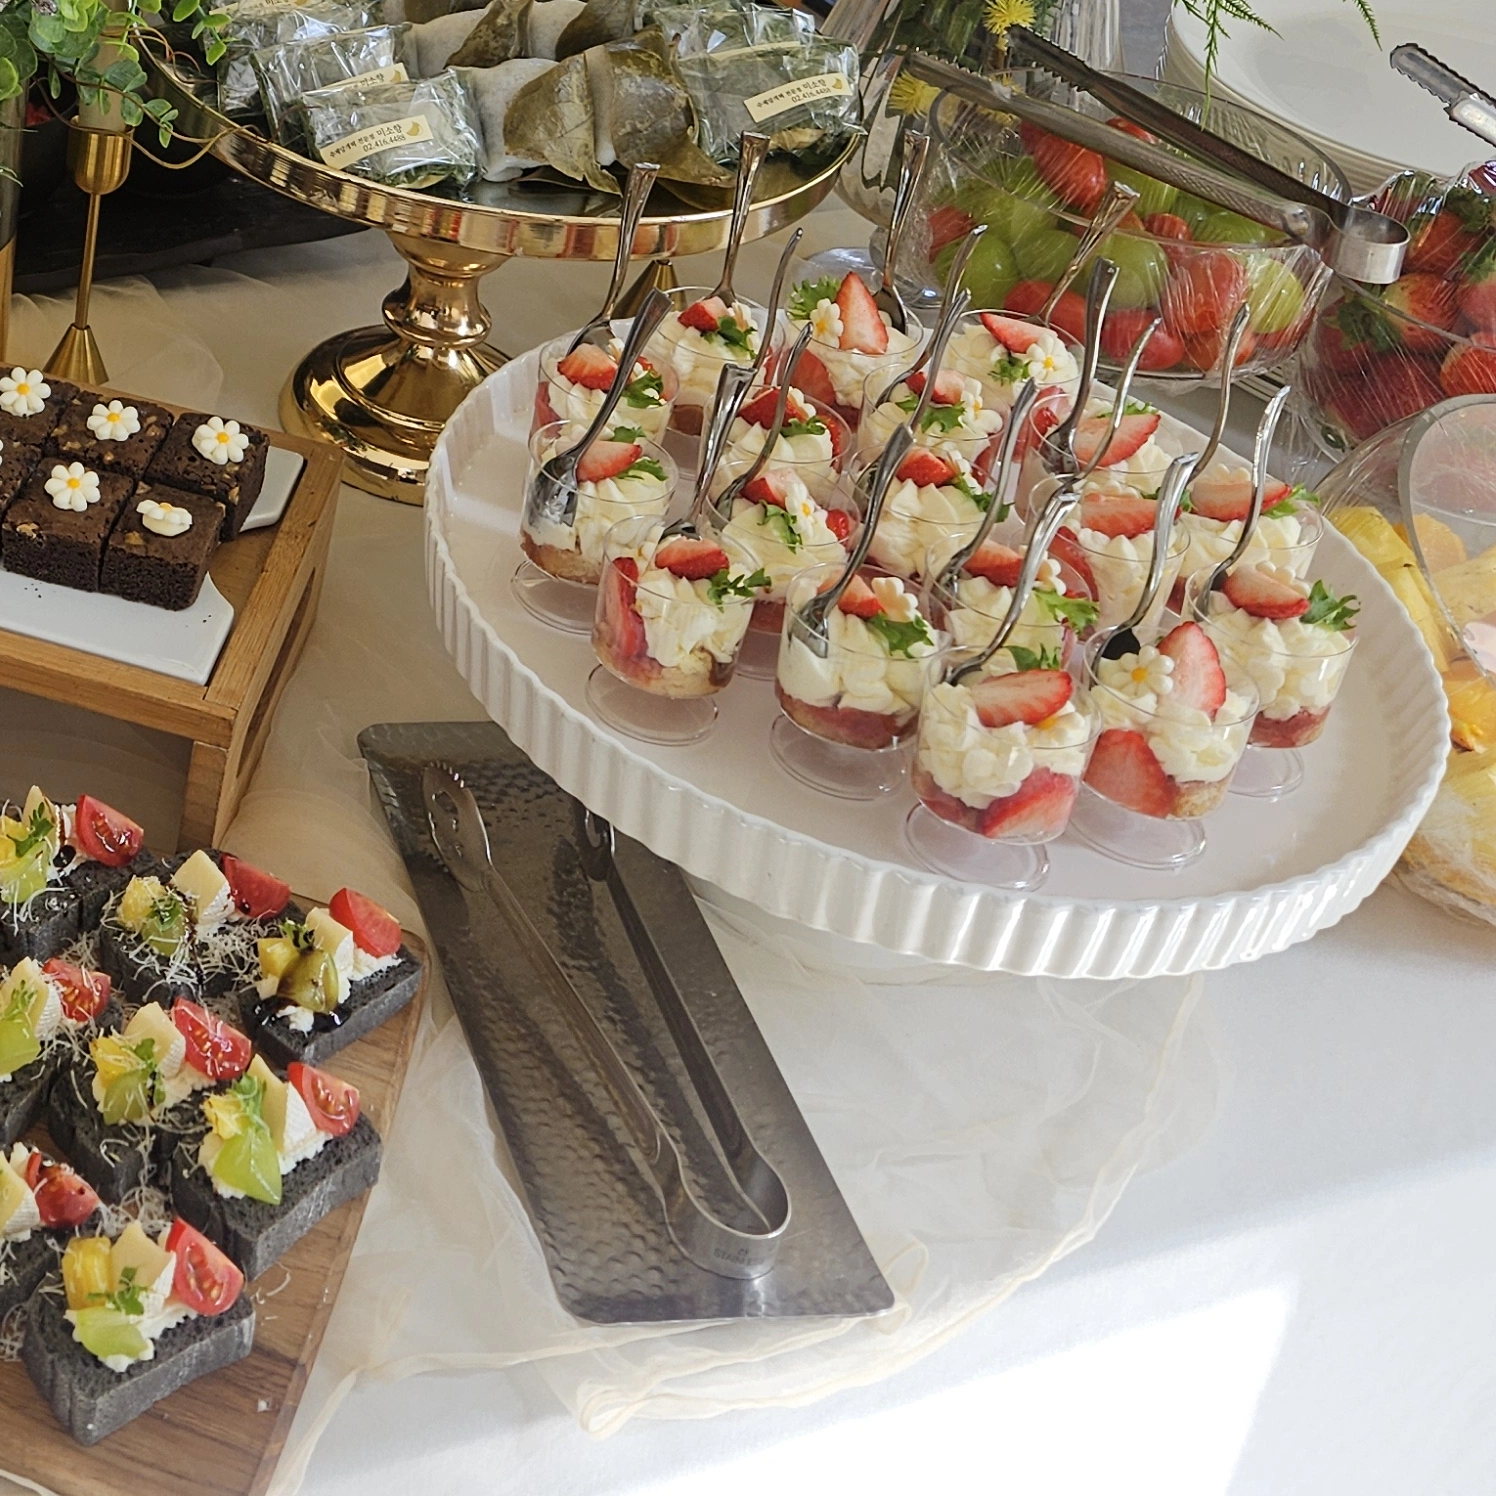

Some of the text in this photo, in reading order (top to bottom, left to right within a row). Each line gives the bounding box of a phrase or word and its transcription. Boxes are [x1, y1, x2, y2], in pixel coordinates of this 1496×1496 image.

[360, 73, 385, 87] 미소향
[376, 123, 402, 137] 미소향
[362, 133, 407, 153] 02.416.4488
